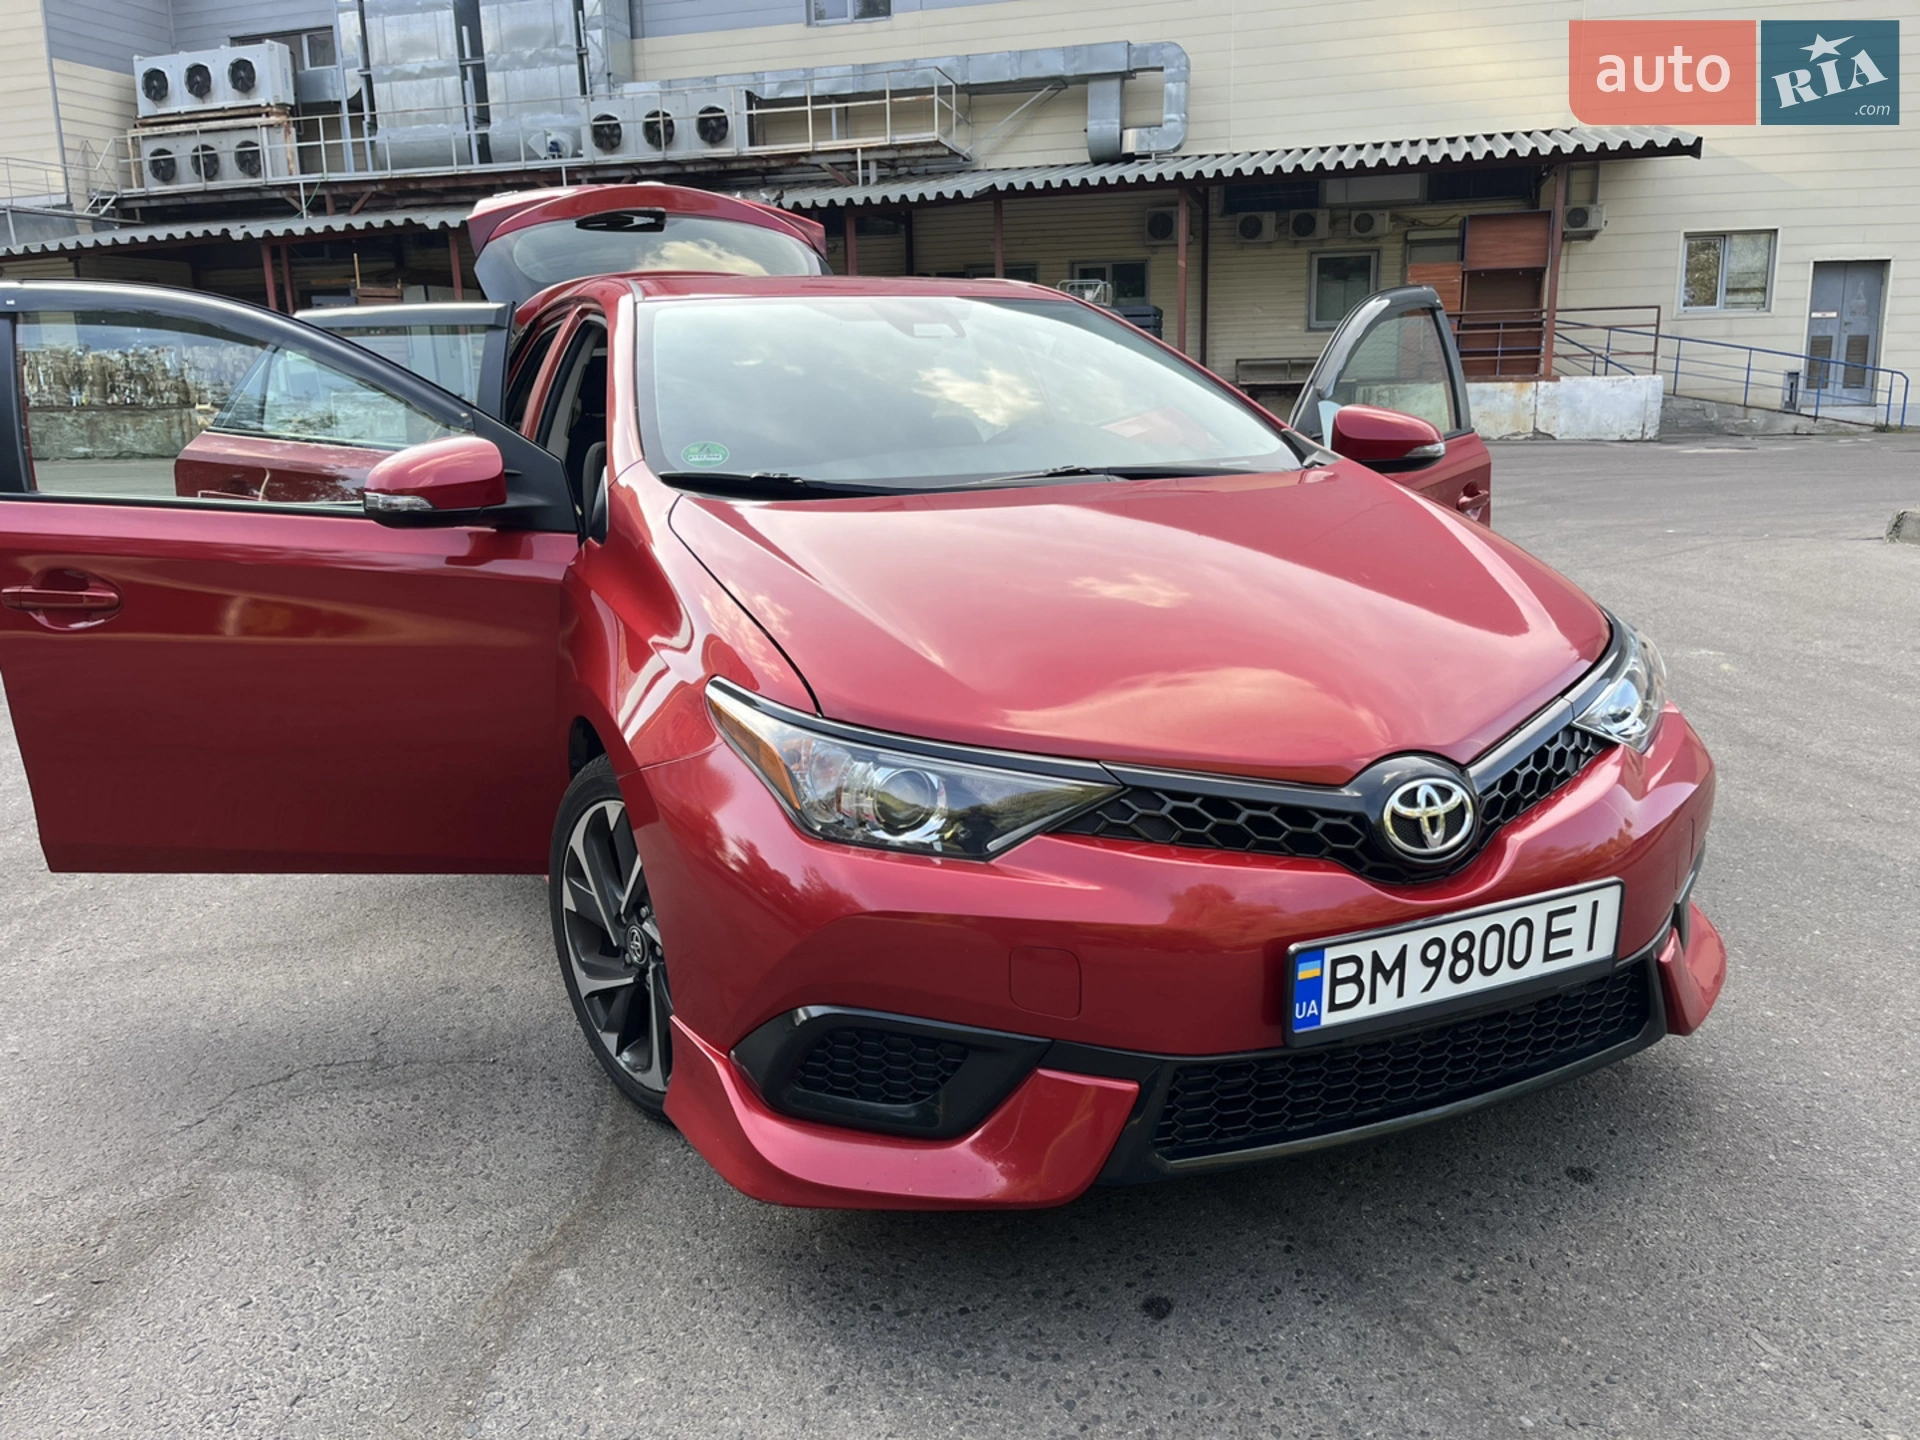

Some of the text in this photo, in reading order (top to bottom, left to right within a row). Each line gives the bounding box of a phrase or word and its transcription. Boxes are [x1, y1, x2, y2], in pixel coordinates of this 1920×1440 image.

[1327, 899, 1600, 1014] BM 9800 EI
[1294, 999, 1319, 1020] UA
